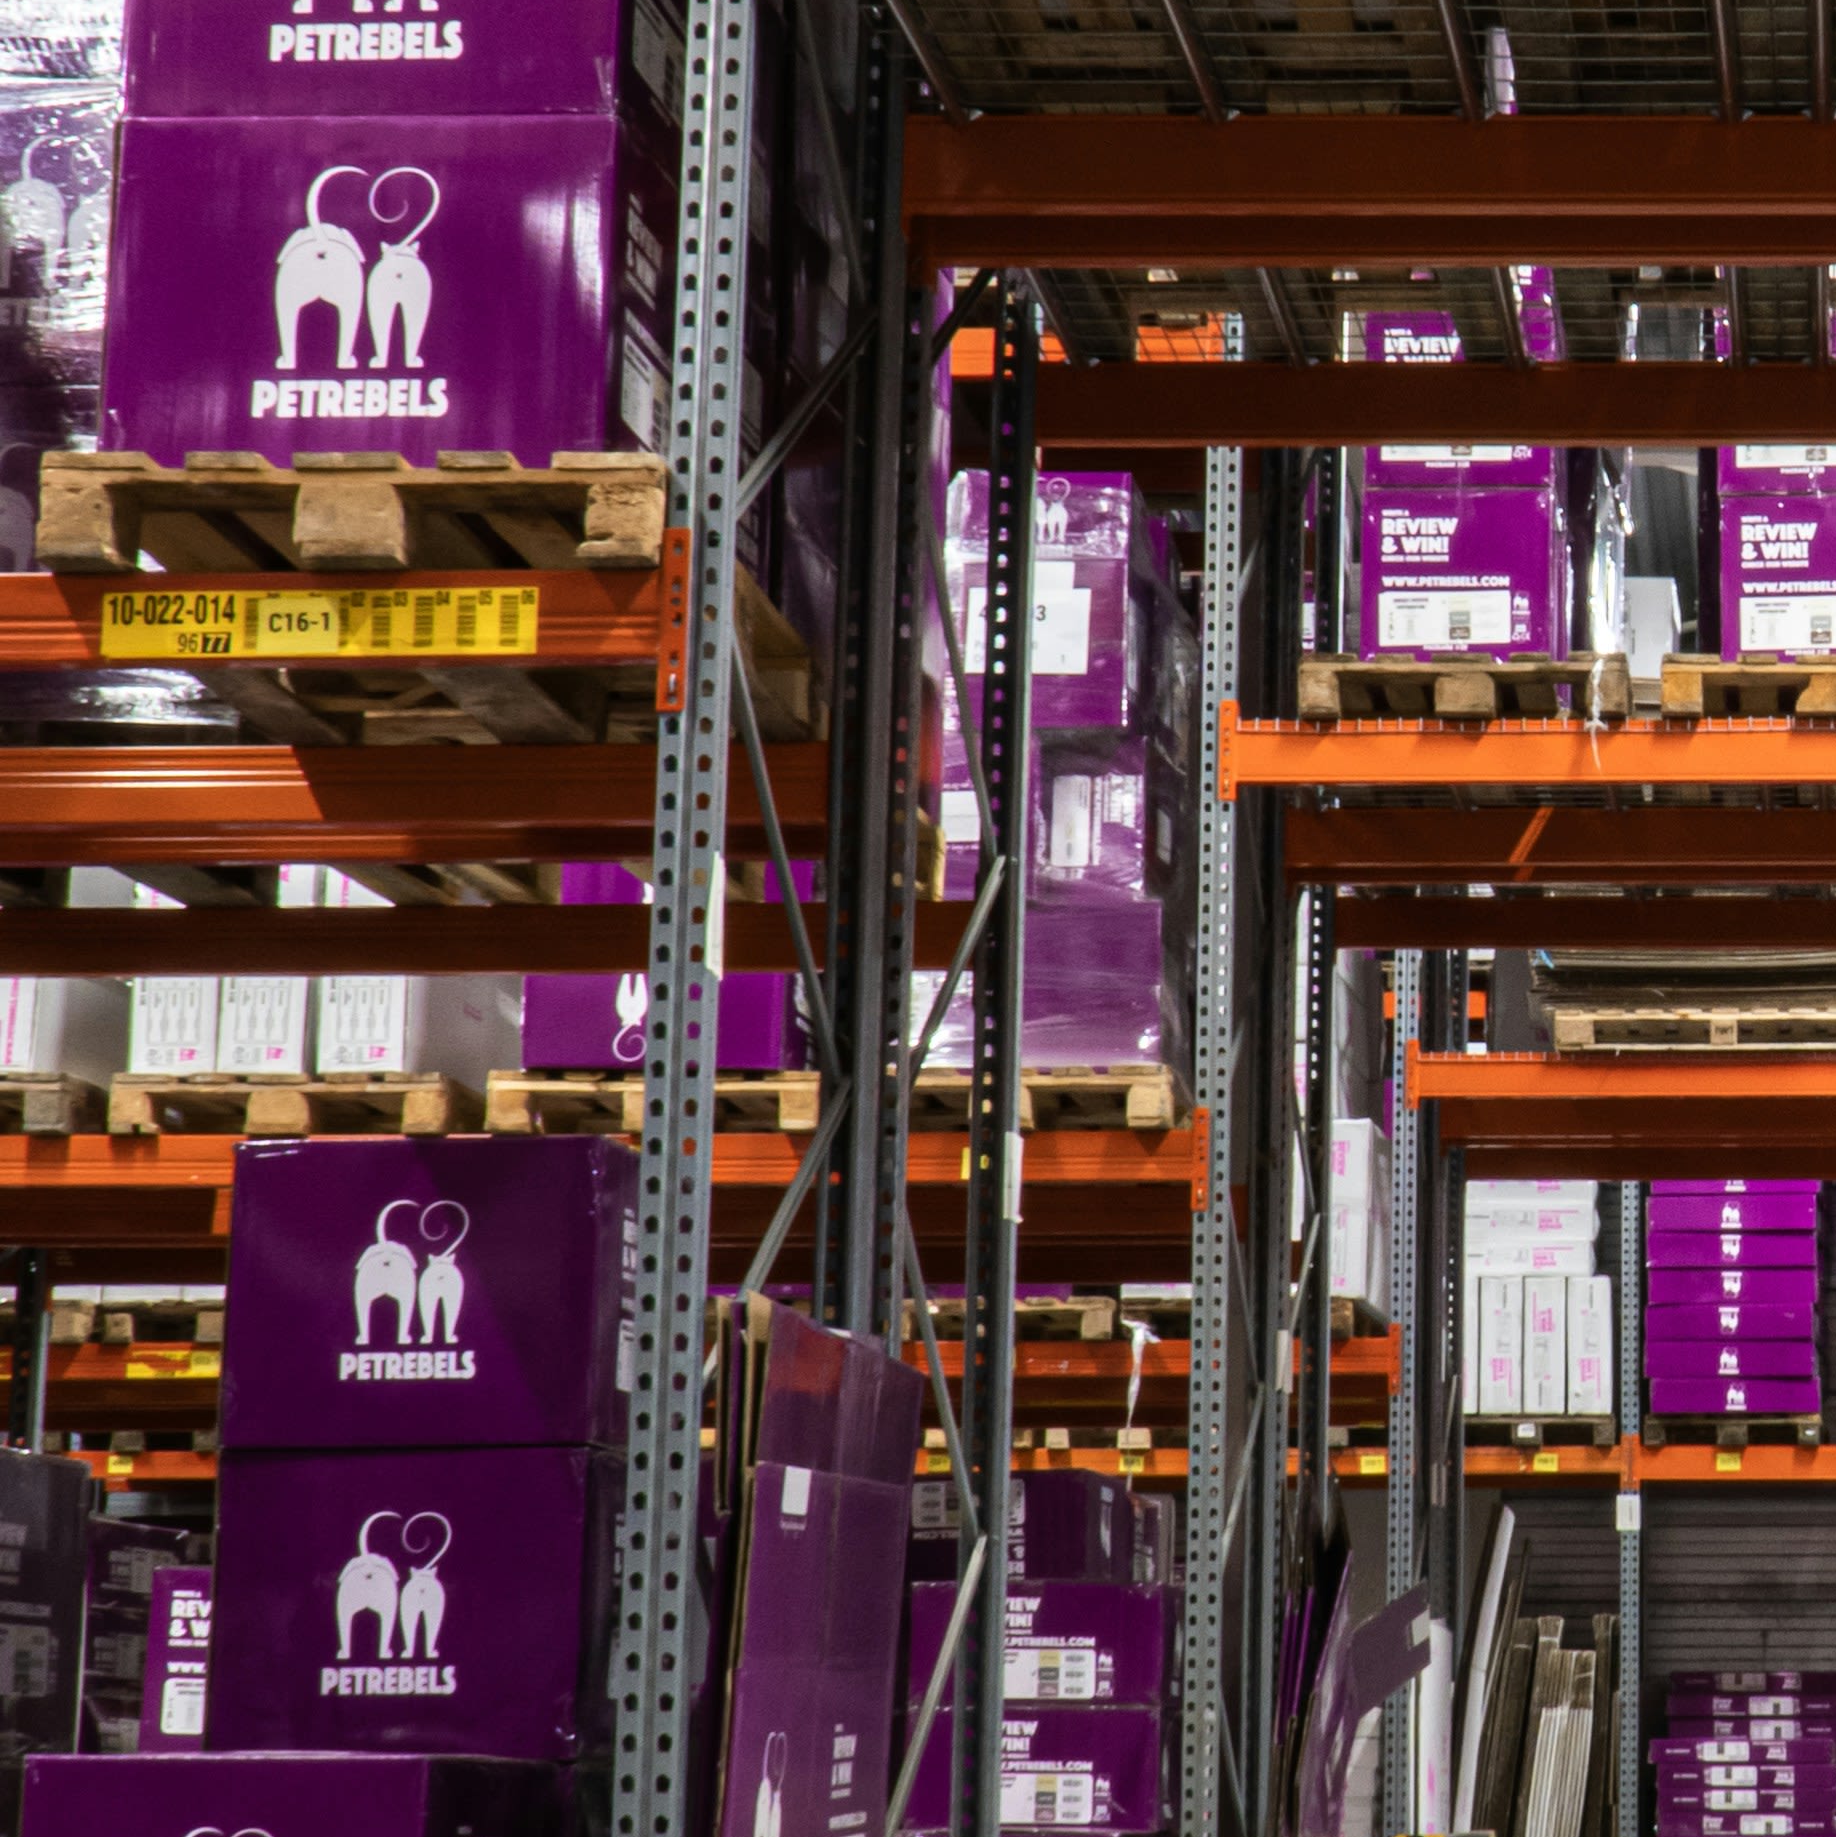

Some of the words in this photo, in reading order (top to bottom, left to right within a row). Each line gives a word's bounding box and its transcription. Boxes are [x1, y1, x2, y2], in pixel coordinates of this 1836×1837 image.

[268, 21, 464, 62] PETREBELS
[250, 377, 450, 420] PETREBELS
[1381, 517, 1459, 535] REVIEW
[1740, 523, 1818, 542] REVIEW
[1381, 535, 1399, 554] &
[1399, 535, 1450, 554] WIN!
[1740, 542, 1759, 560] &
[1762, 541, 1810, 560] WIN!
[107, 594, 236, 627] 10-022-014
[268, 612, 331, 633] C16-1
[338, 1350, 477, 1382] PETREBELS
[170, 1598, 213, 1618] REV
[319, 1666, 458, 1697] PETREBELS
